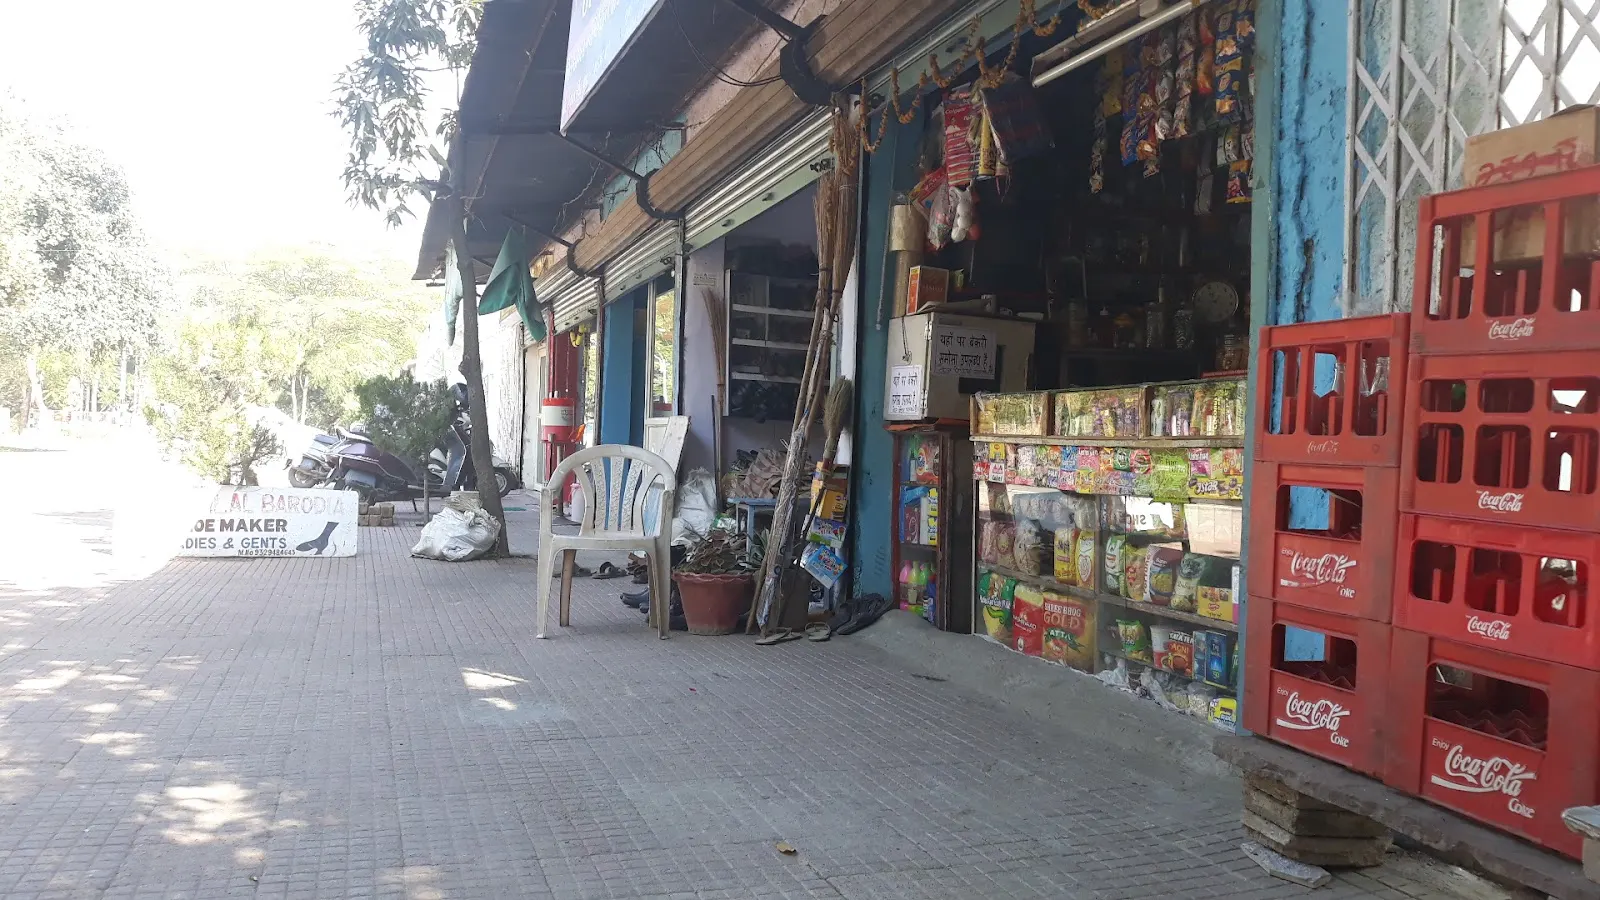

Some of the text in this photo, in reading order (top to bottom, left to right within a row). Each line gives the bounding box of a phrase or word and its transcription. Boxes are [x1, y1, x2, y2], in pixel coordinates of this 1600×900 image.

[219, 518, 288, 532] MAKER
[222, 537, 234, 549] &
[240, 537, 287, 549] GENTS
[1044, 611, 1080, 629] GOLD
[1286, 692, 1345, 731] Coca-Cola
[1330, 732, 1349, 748] Coke
[1432, 738, 1449, 751] Enjoy
[1445, 745, 1530, 797] Coca-Cola
